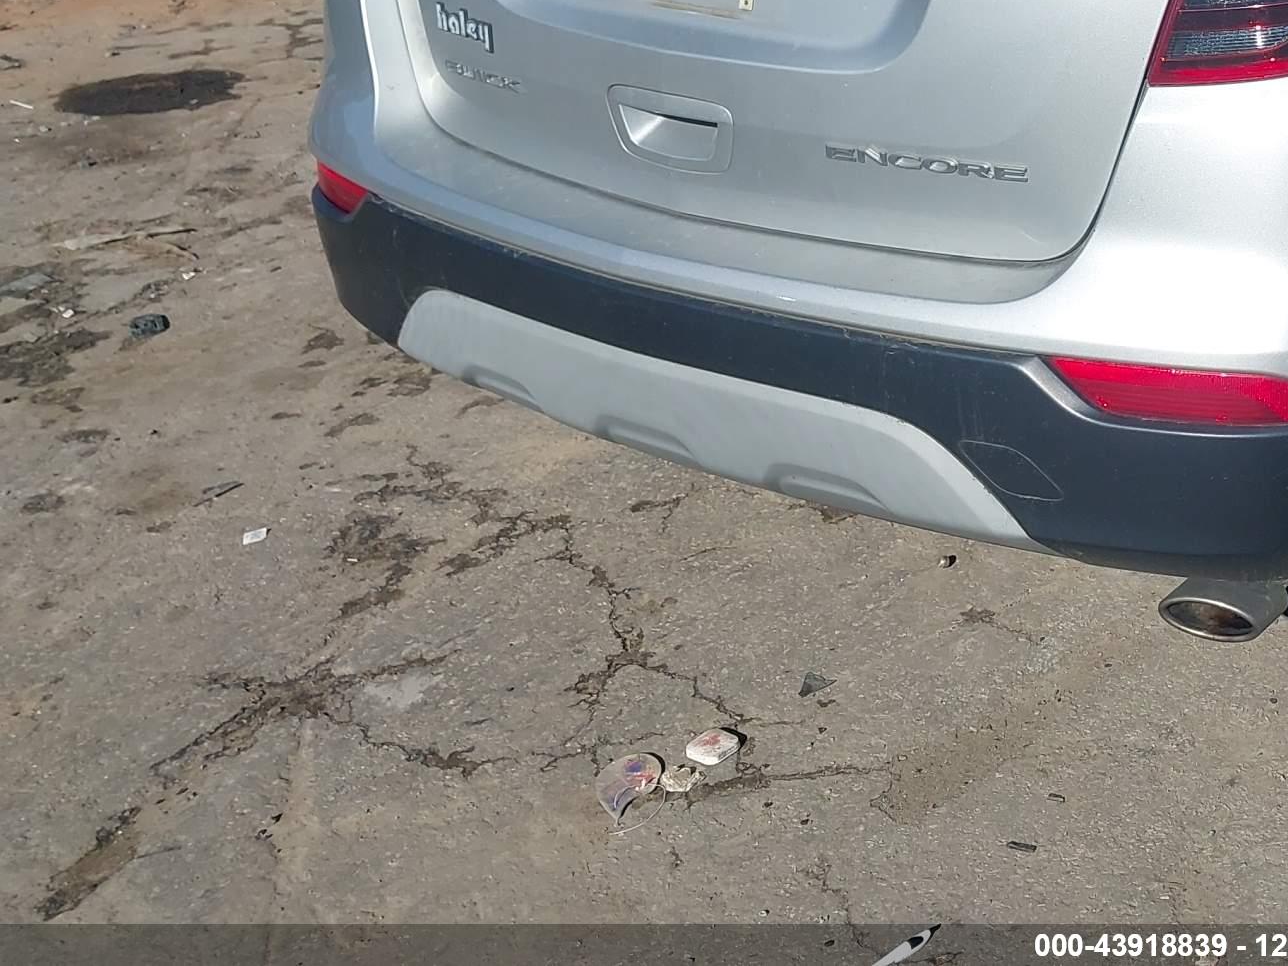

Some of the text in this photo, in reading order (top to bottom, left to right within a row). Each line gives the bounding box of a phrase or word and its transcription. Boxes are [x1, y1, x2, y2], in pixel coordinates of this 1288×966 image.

[435, 1, 494, 54] haley
[444, 59, 521, 94] BUICK
[824, 142, 1029, 183] ENCORE
